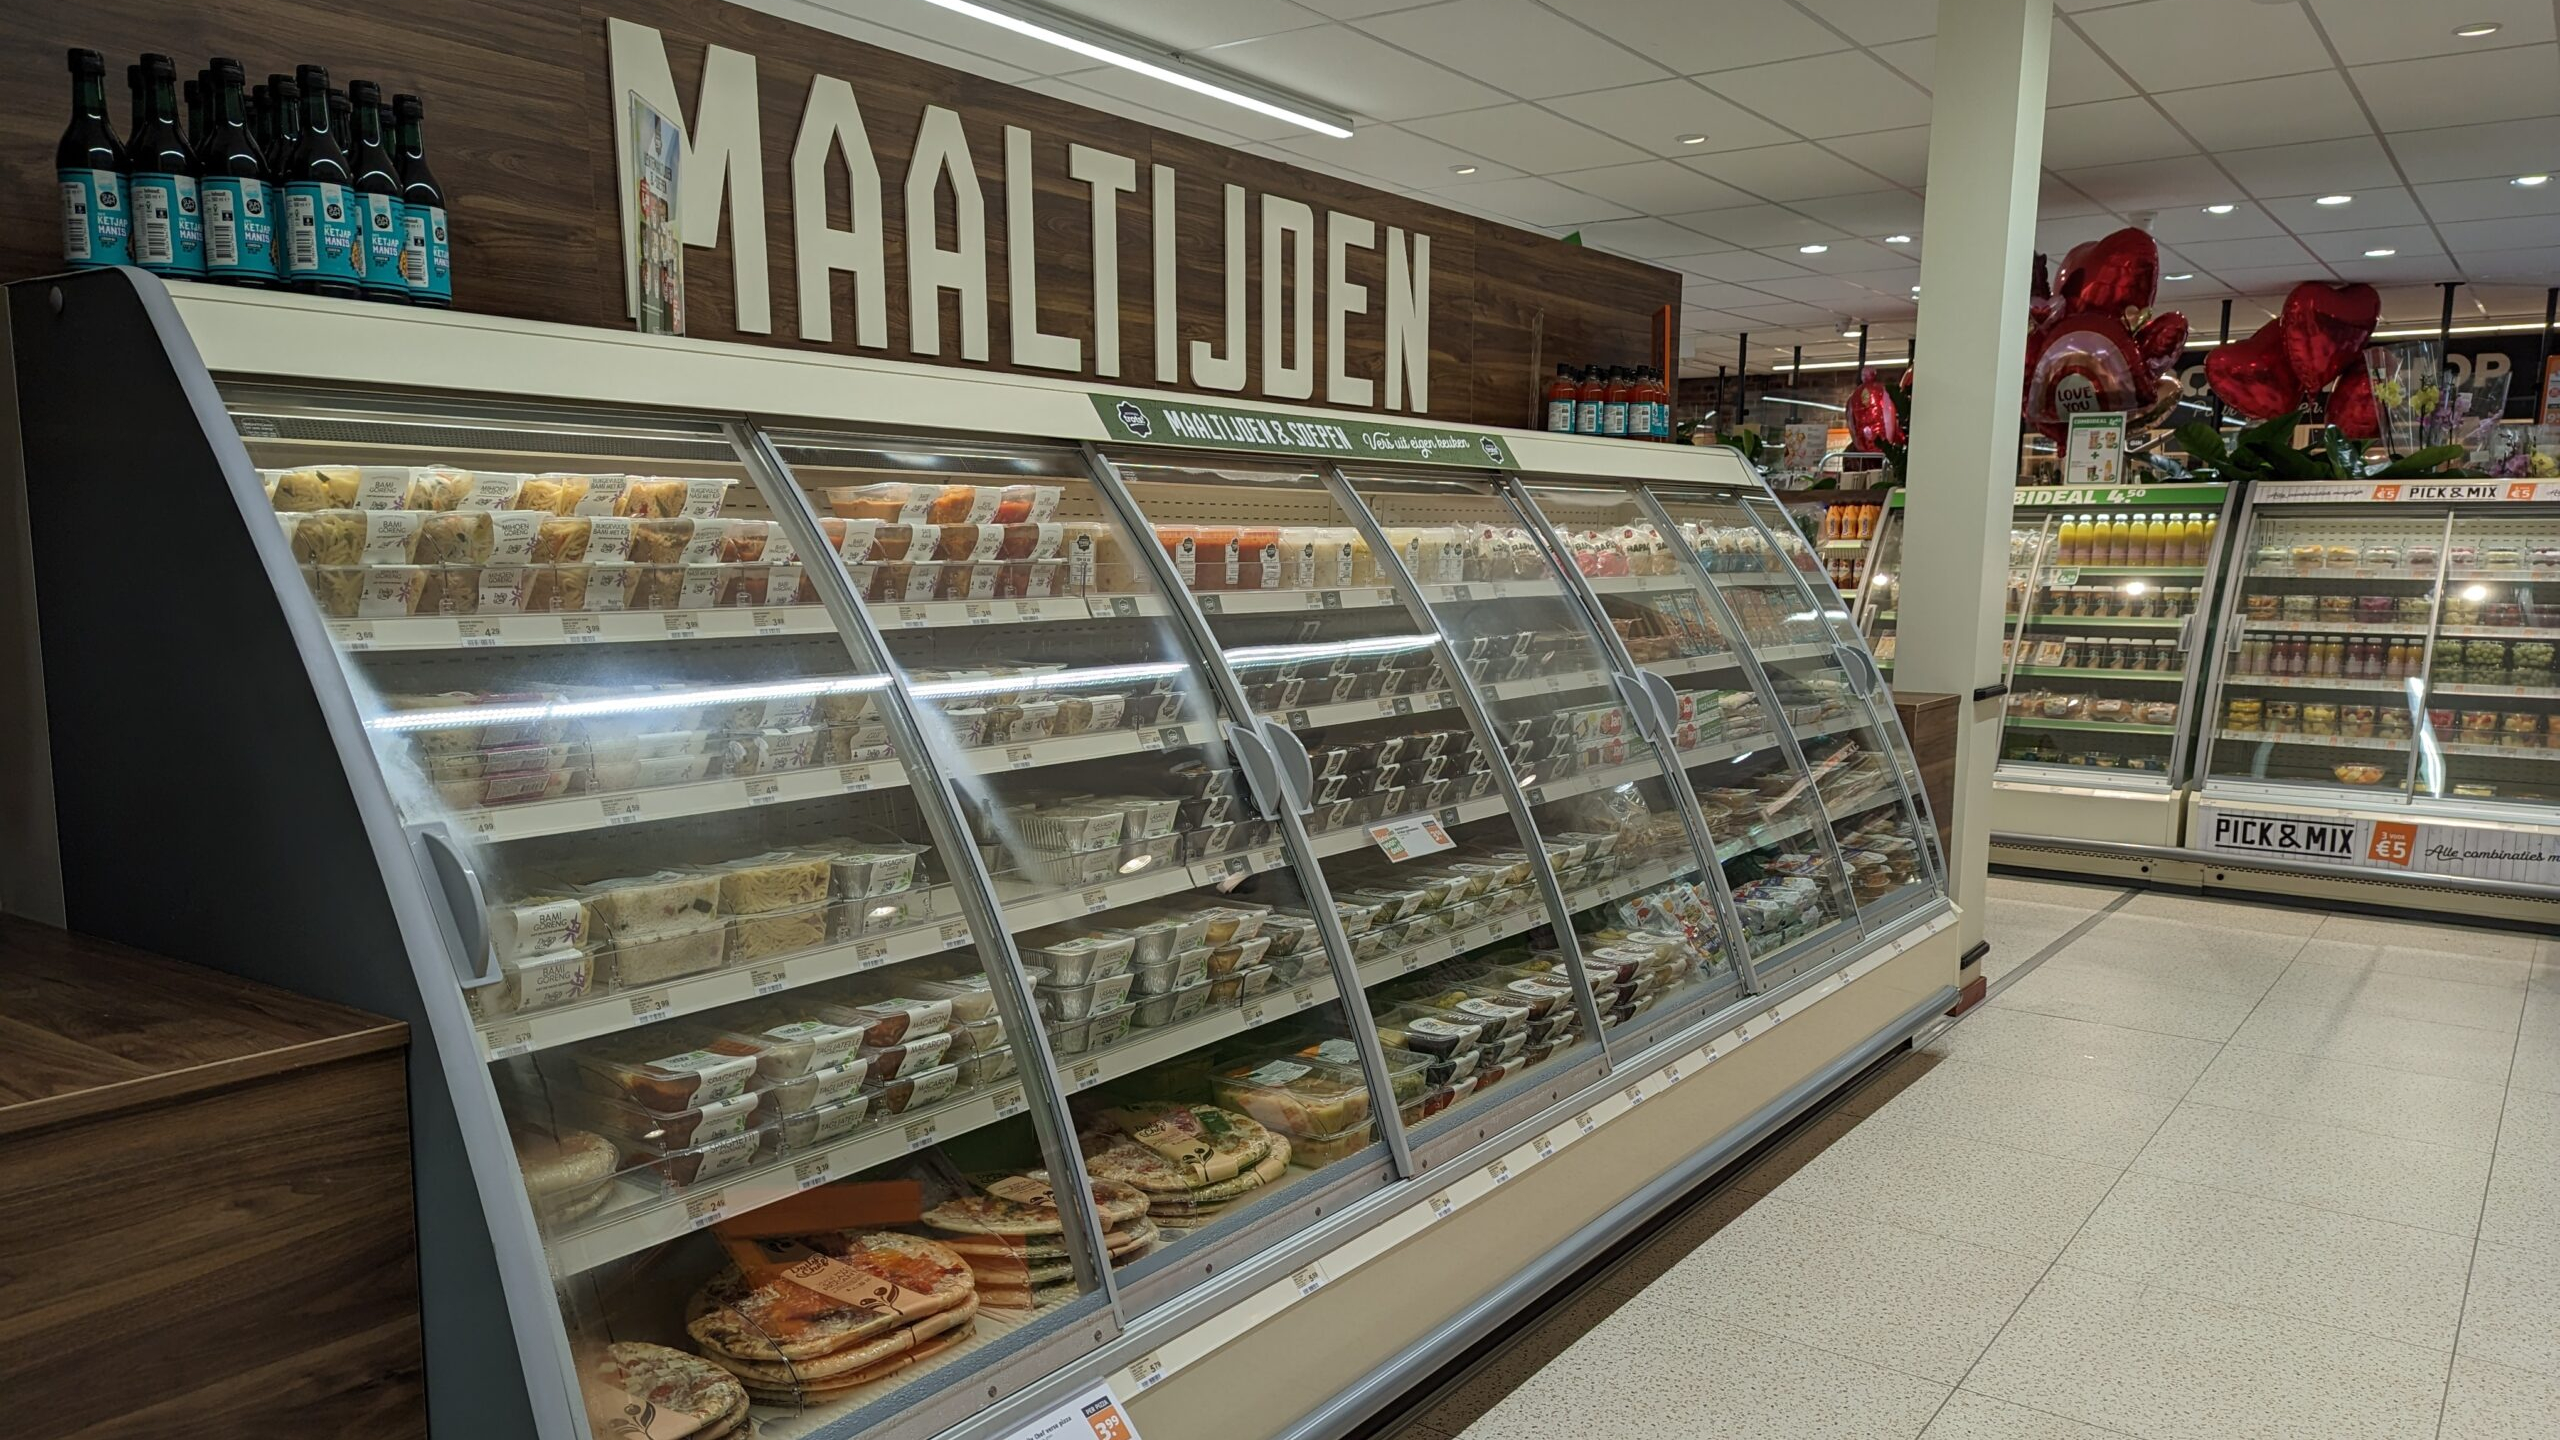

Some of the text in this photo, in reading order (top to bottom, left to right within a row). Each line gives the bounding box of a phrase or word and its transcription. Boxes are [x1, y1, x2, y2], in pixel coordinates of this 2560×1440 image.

[97, 214, 128, 228] KETJAP
[606, 16, 1431, 414] MAALTIJDEN
[98, 224, 127, 237] MANIS
[244, 221, 271, 232] KETJAP
[324, 227, 352, 239] KETJAP
[245, 231, 270, 243] MANIS
[325, 236, 351, 248] MANIS
[372, 236, 400, 247] KETJAP
[372, 245, 398, 257] MANIS
[2058, 386, 2093, 402] LOVE
[2063, 400, 2090, 413] YOU
[1162, 408, 1354, 450] MAALTIJDEN & SOEPEN
[1363, 432, 1470, 459] Vers uit eigen keuken
[374, 481, 394, 489] BAMI
[480, 485, 510, 493] MIHOEN
[2013, 489, 2097, 506] BIDEAL
[2409, 486, 2446, 499] PICK
[2450, 487, 2466, 498] &
[2467, 486, 2498, 499] MIX
[382, 520, 402, 528] BAMI
[502, 523, 529, 531] MIHOEN
[2215, 818, 2354, 854] PICK & MIX
[2380, 831, 2388, 840] 3
[2375, 841, 2406, 859] €5
[2424, 844, 2464, 862] Alle
[2462, 848, 2546, 862] combinaties
[879, 856, 909, 869] LASAGNE
[539, 911, 562, 923] BAMI
[533, 918, 568, 932] GORENG
[542, 963, 565, 976] BAMI
[536, 971, 571, 985] GORENG
[912, 1014, 950, 1029] MACARONI
[816, 1039, 861, 1056] TAGLIATELLE
[911, 1037, 951, 1052] MACARONI
[707, 1067, 752, 1084] SPAGHETTI
[918, 1074, 957, 1091] MACARONI
[819, 1075, 864, 1094] TAGLIATELLE
[821, 1112, 864, 1130] TAGLIATELLE
[710, 1134, 756, 1154] SPAGHETTI
[1085, 1406, 1096, 1416] PER
[1033, 1416, 1073, 1440] Chef verse pizza
